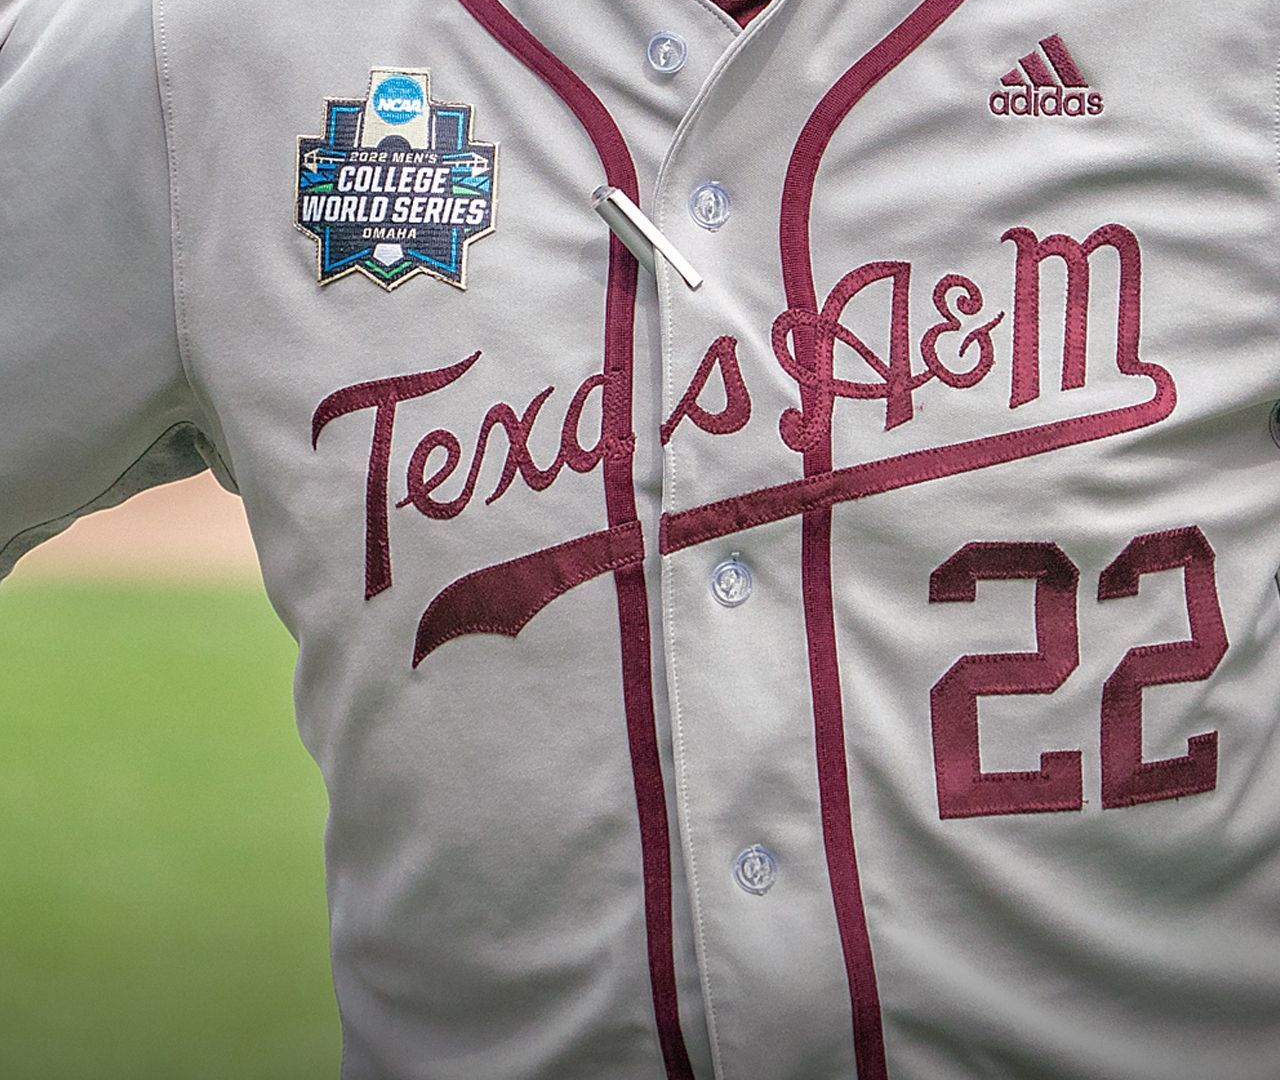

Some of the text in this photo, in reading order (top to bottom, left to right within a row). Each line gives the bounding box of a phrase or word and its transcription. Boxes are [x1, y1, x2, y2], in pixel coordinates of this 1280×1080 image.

[376, 97, 422, 113] NCAA
[988, 84, 1105, 117] adidas
[349, 152, 438, 164] 2022 MEN'S
[336, 166, 452, 194] COLLEGE
[301, 195, 488, 225] WORLD SERIES
[362, 226, 418, 239] OMAHA
[311, 222, 1178, 601] Texas A&M
[929, 525, 1230, 820] 22
